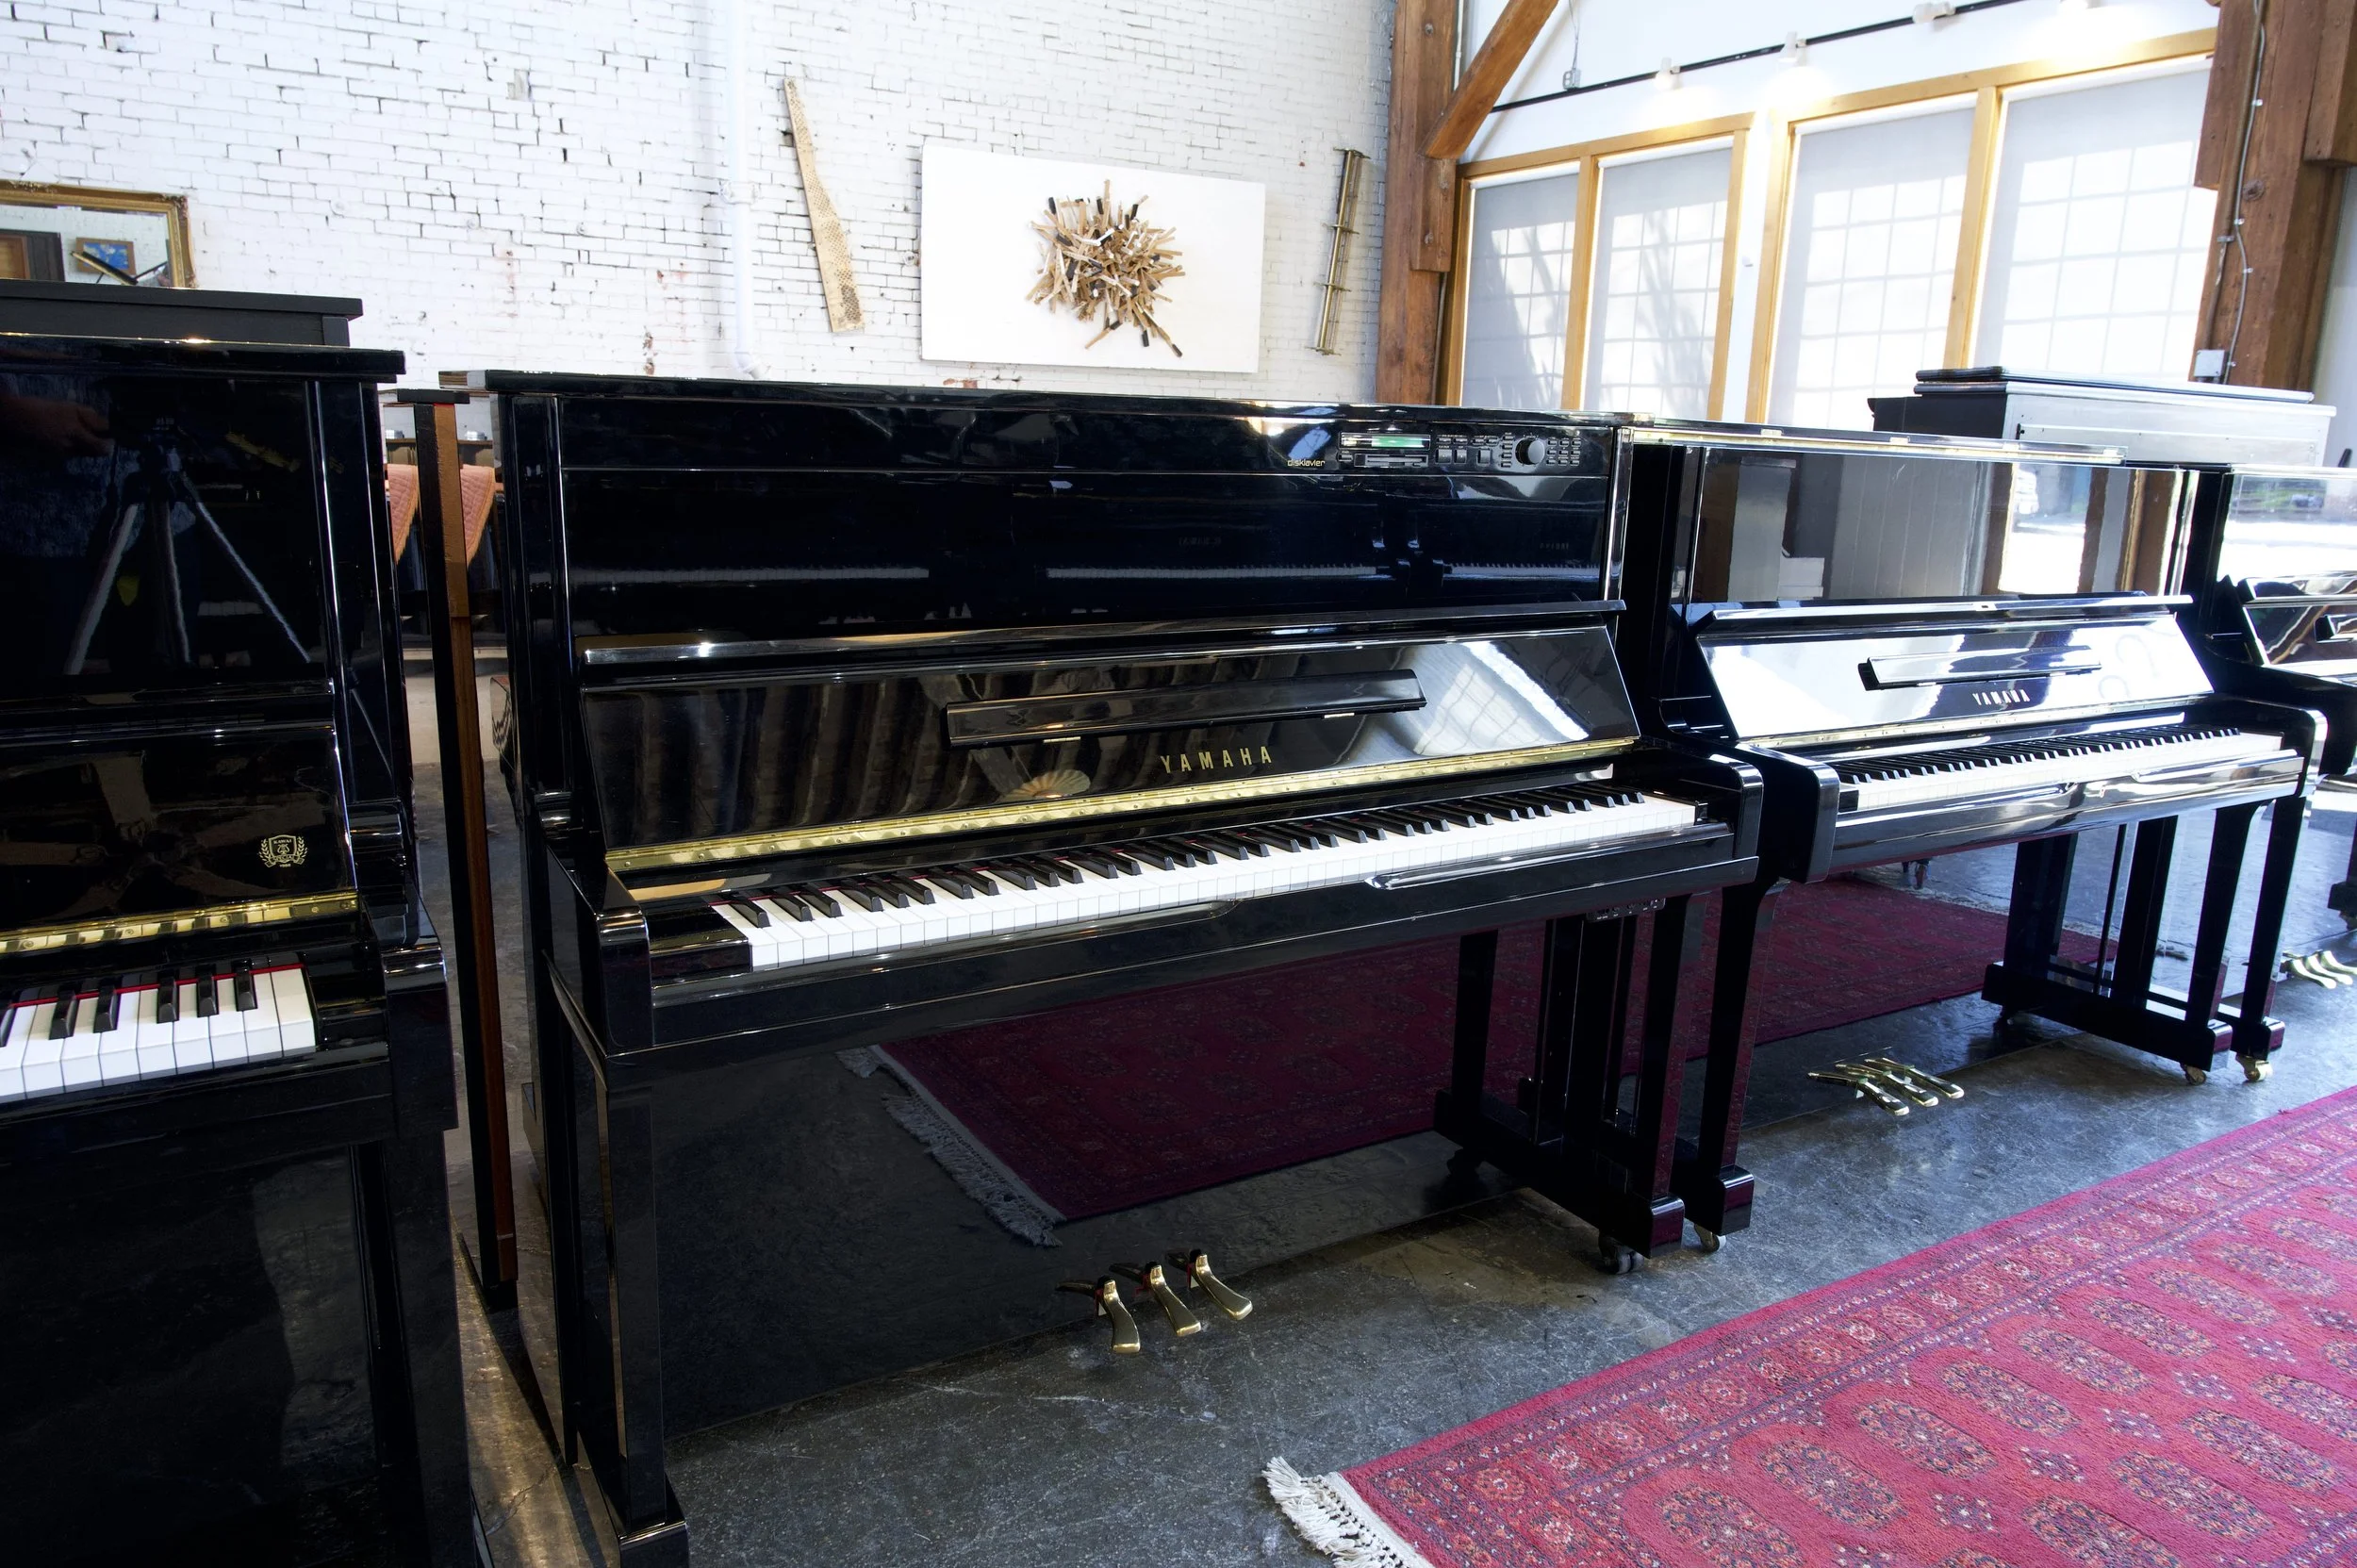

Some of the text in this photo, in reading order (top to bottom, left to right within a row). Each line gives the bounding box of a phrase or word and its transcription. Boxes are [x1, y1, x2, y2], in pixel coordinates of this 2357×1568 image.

[1287, 458, 1326, 467] disklavier
[1972, 689, 2031, 706] YAMAHA
[1161, 746, 1272, 774] YAMAHA
